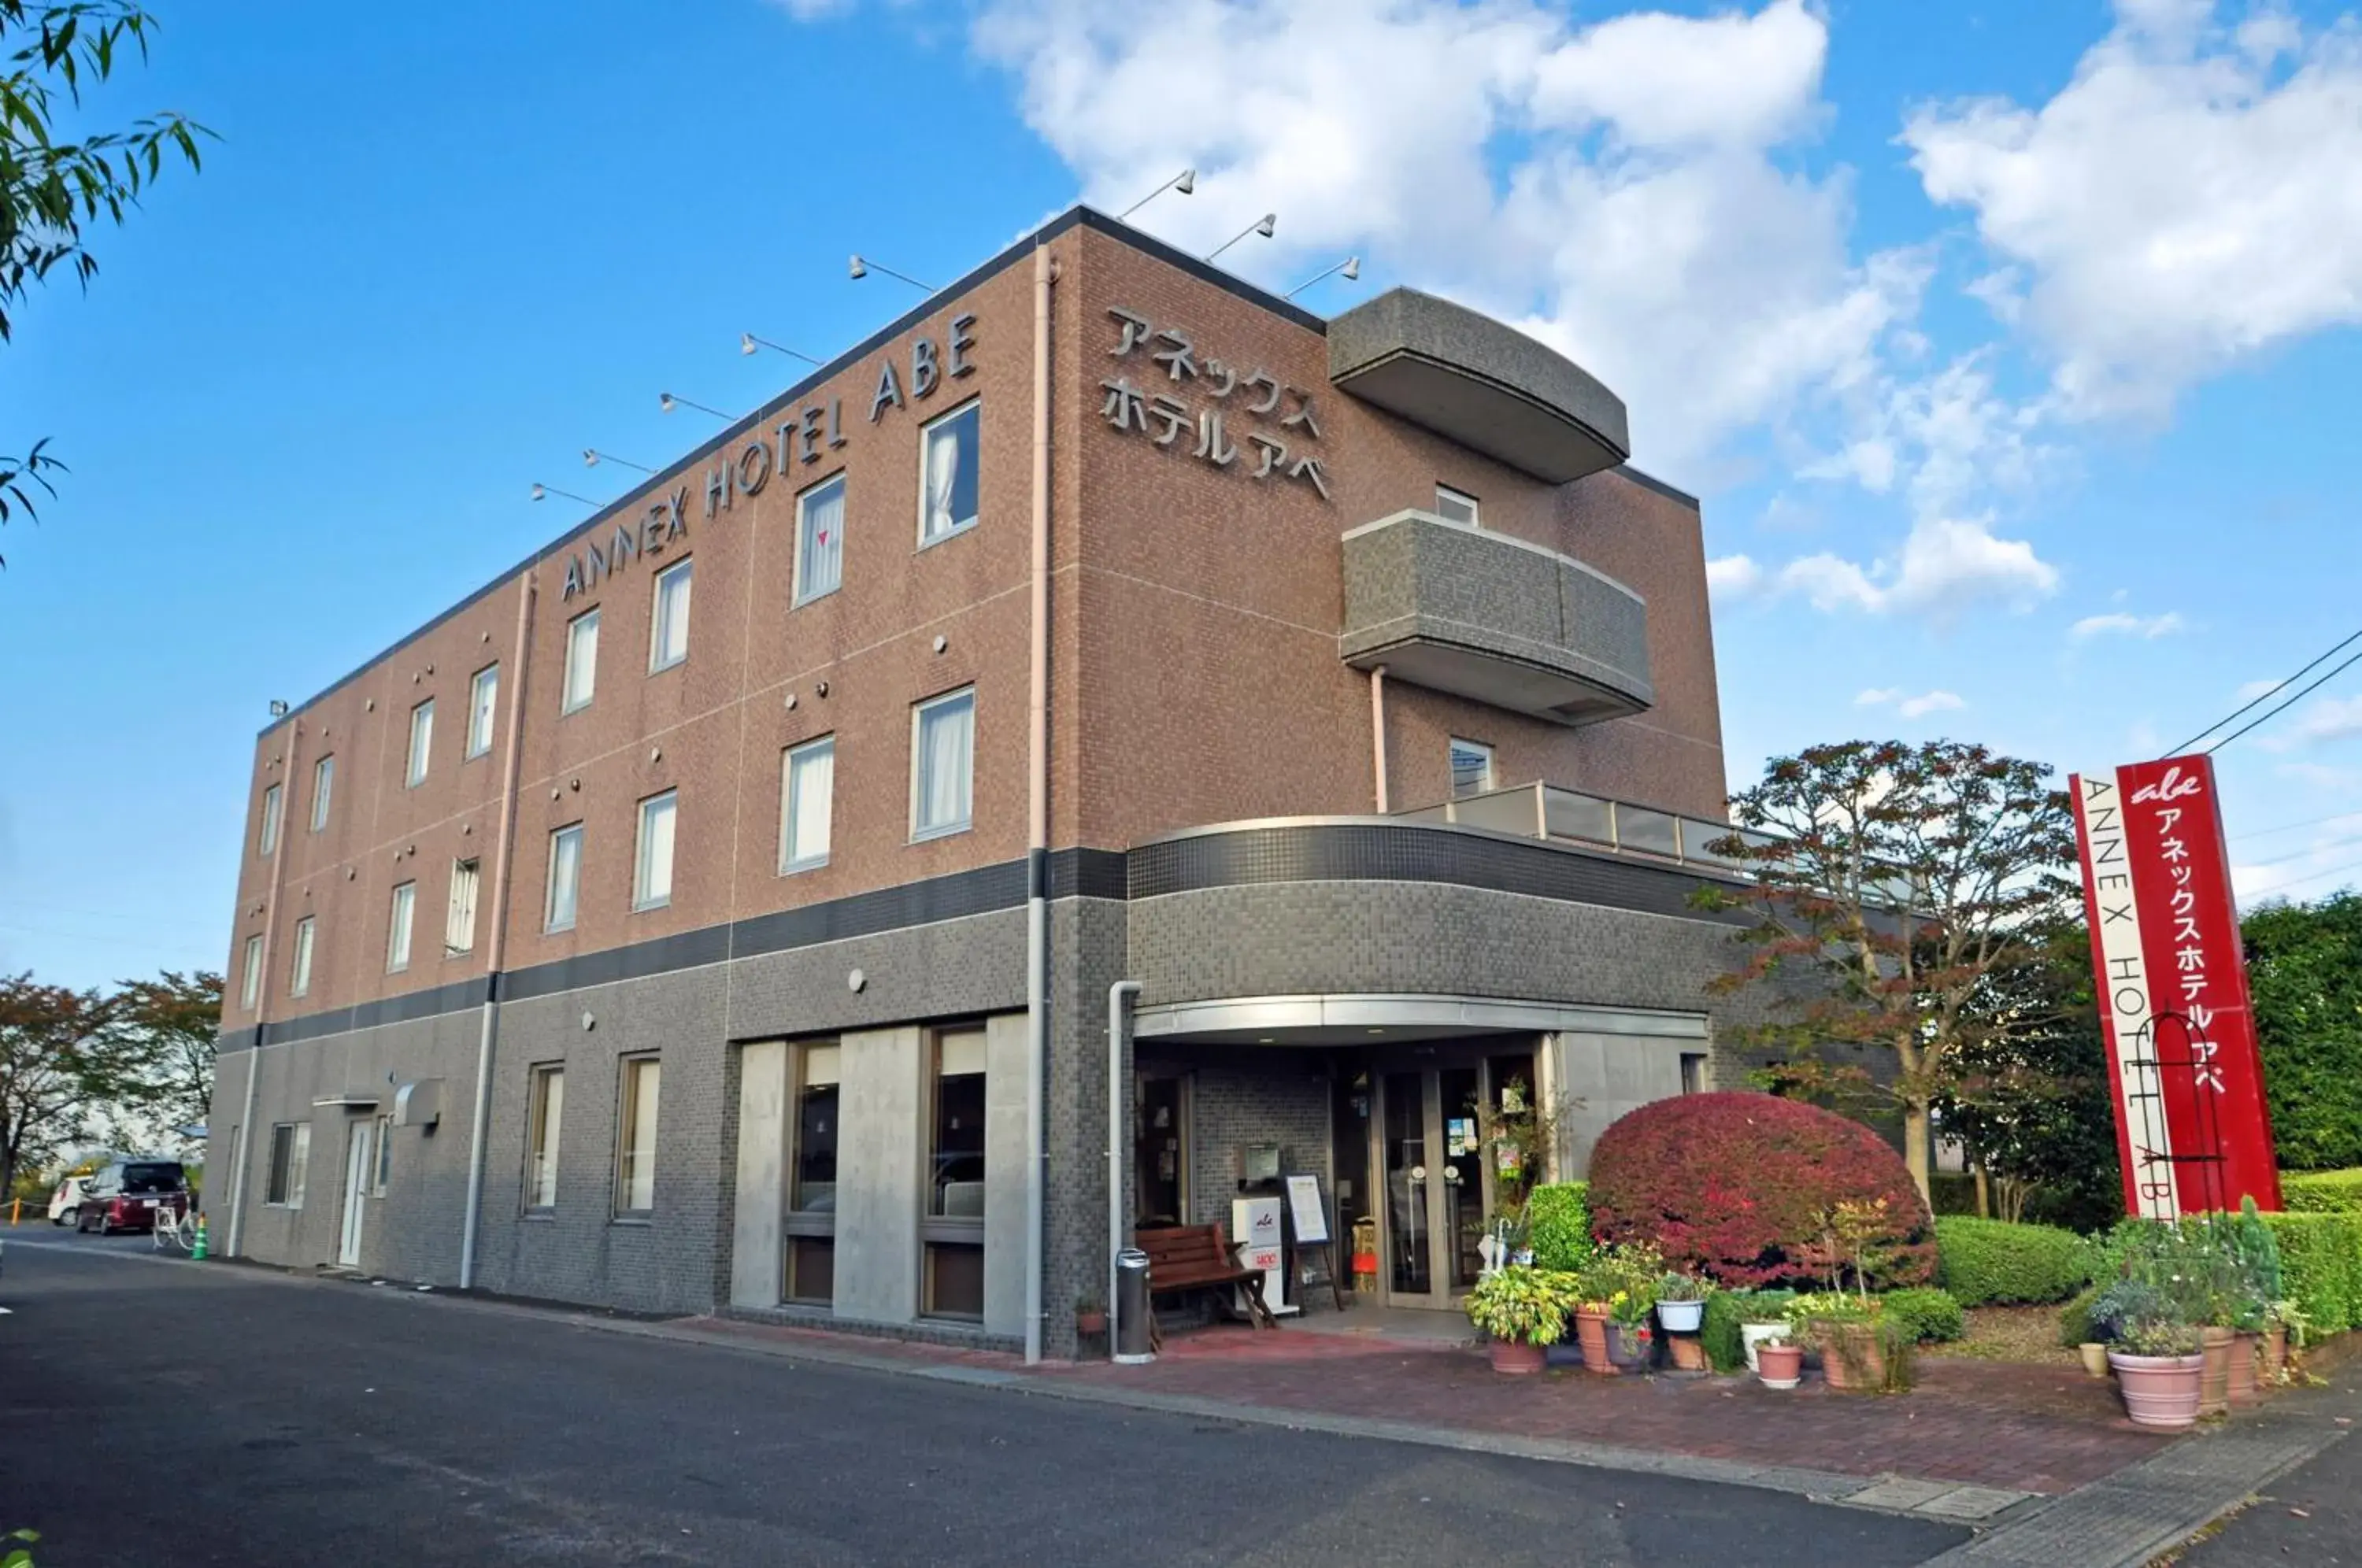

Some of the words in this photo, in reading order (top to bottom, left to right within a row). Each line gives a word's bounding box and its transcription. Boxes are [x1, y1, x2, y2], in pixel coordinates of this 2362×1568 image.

[563, 486, 689, 601] ANNEX
[705, 395, 848, 519] HOTEL
[870, 313, 977, 424] ABE
[1106, 305, 1320, 438] アネックス
[2131, 767, 2201, 804] abe
[2084, 778, 2134, 924] ANNEX
[2110, 956, 2160, 1108] HOTEL
[2135, 1145, 2175, 1222] AB
